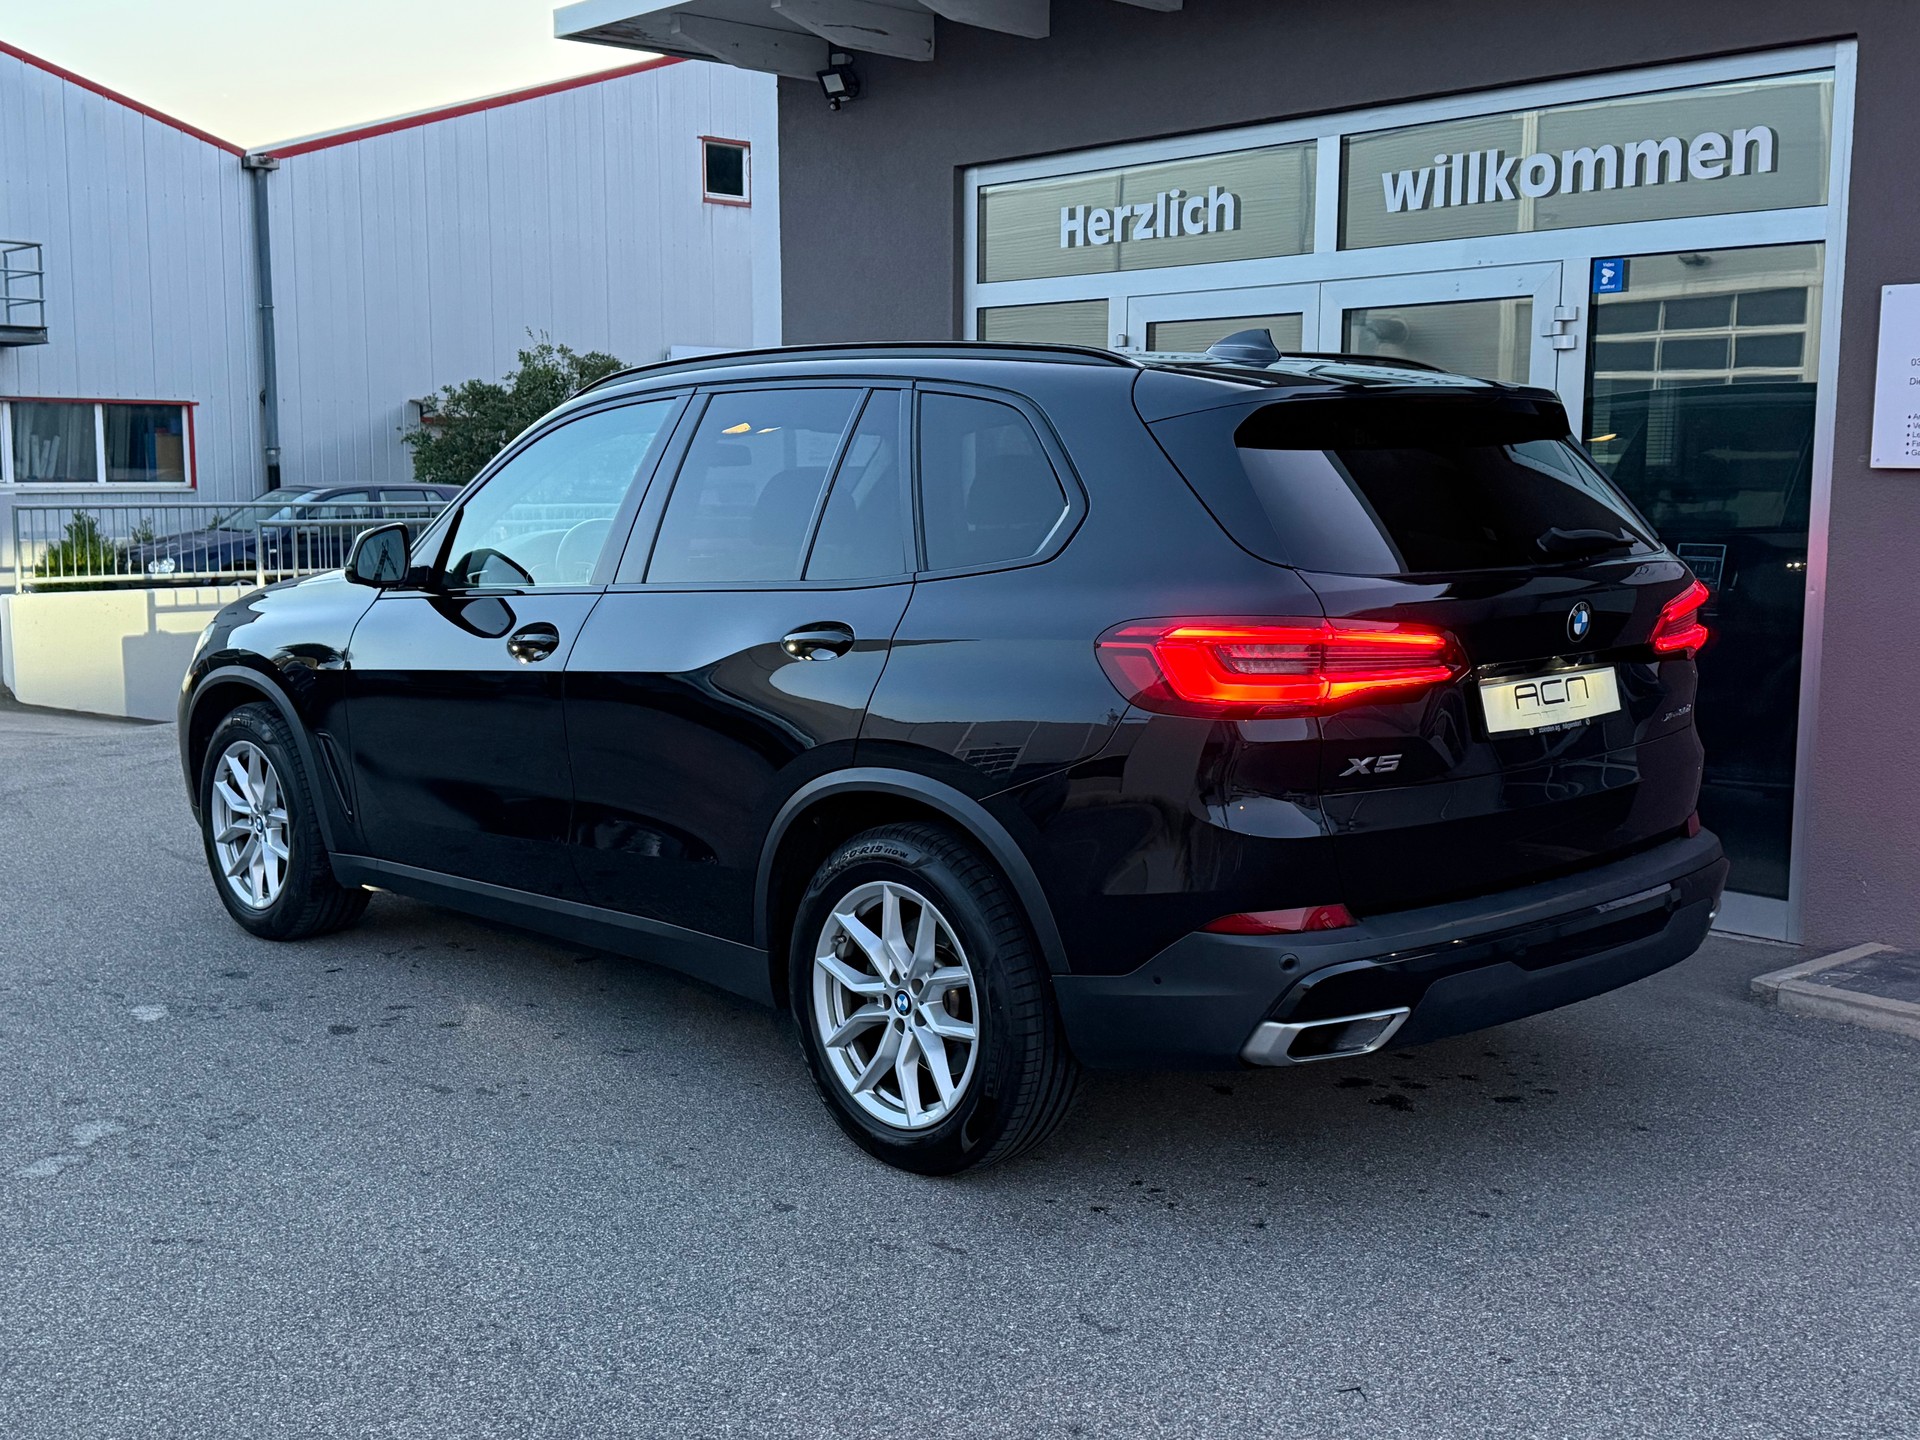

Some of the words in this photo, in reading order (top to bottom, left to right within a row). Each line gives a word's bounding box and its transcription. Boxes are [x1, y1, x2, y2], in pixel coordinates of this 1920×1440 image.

[1060, 185, 1235, 248] Herzlich
[1381, 125, 1774, 212] willkommen
[1339, 754, 1402, 776] X5
